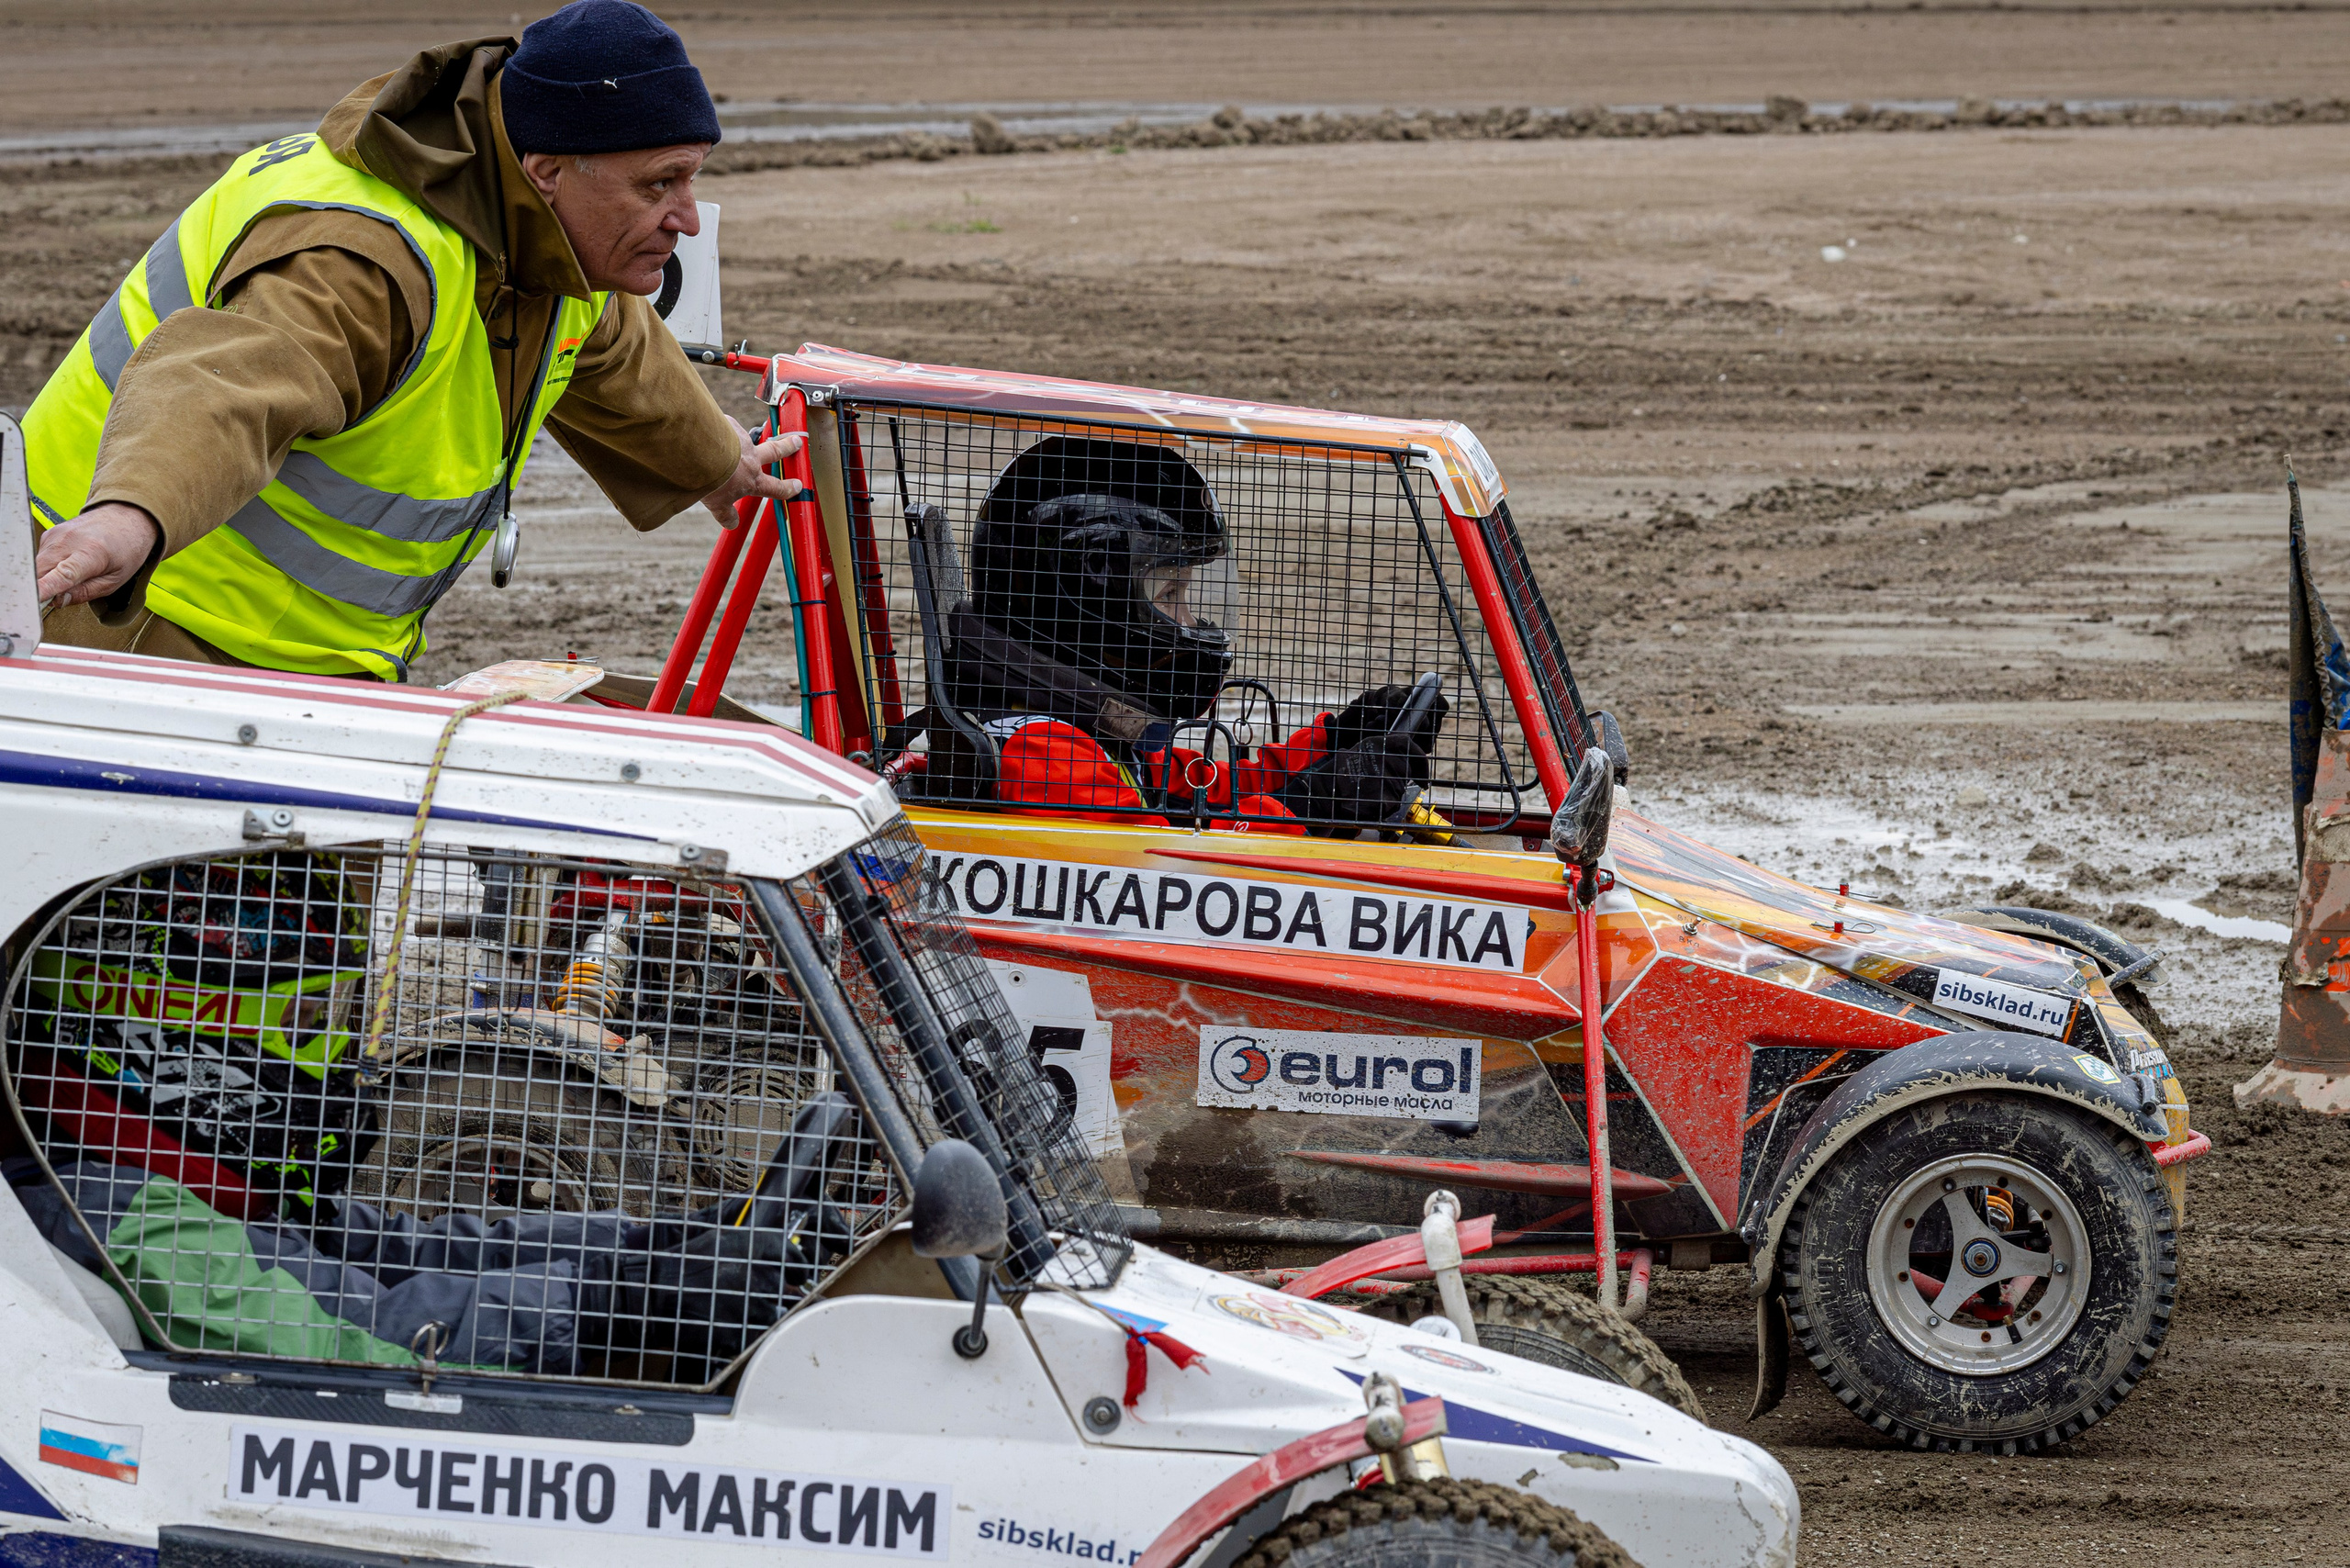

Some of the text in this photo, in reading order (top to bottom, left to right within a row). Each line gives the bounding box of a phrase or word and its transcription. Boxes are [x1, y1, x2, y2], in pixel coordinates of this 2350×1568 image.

[926, 855, 1515, 968] КОШКАРОВА ВИКА
[1938, 981, 2065, 1026] sibsklad.ru
[1279, 1047, 1472, 1094] eurol
[1298, 1091, 1453, 1112] моторные масла
[241, 1433, 937, 1552] МАРЧЕНКО МАКСИМ
[978, 1518, 1143, 1566] sibsklad.r
